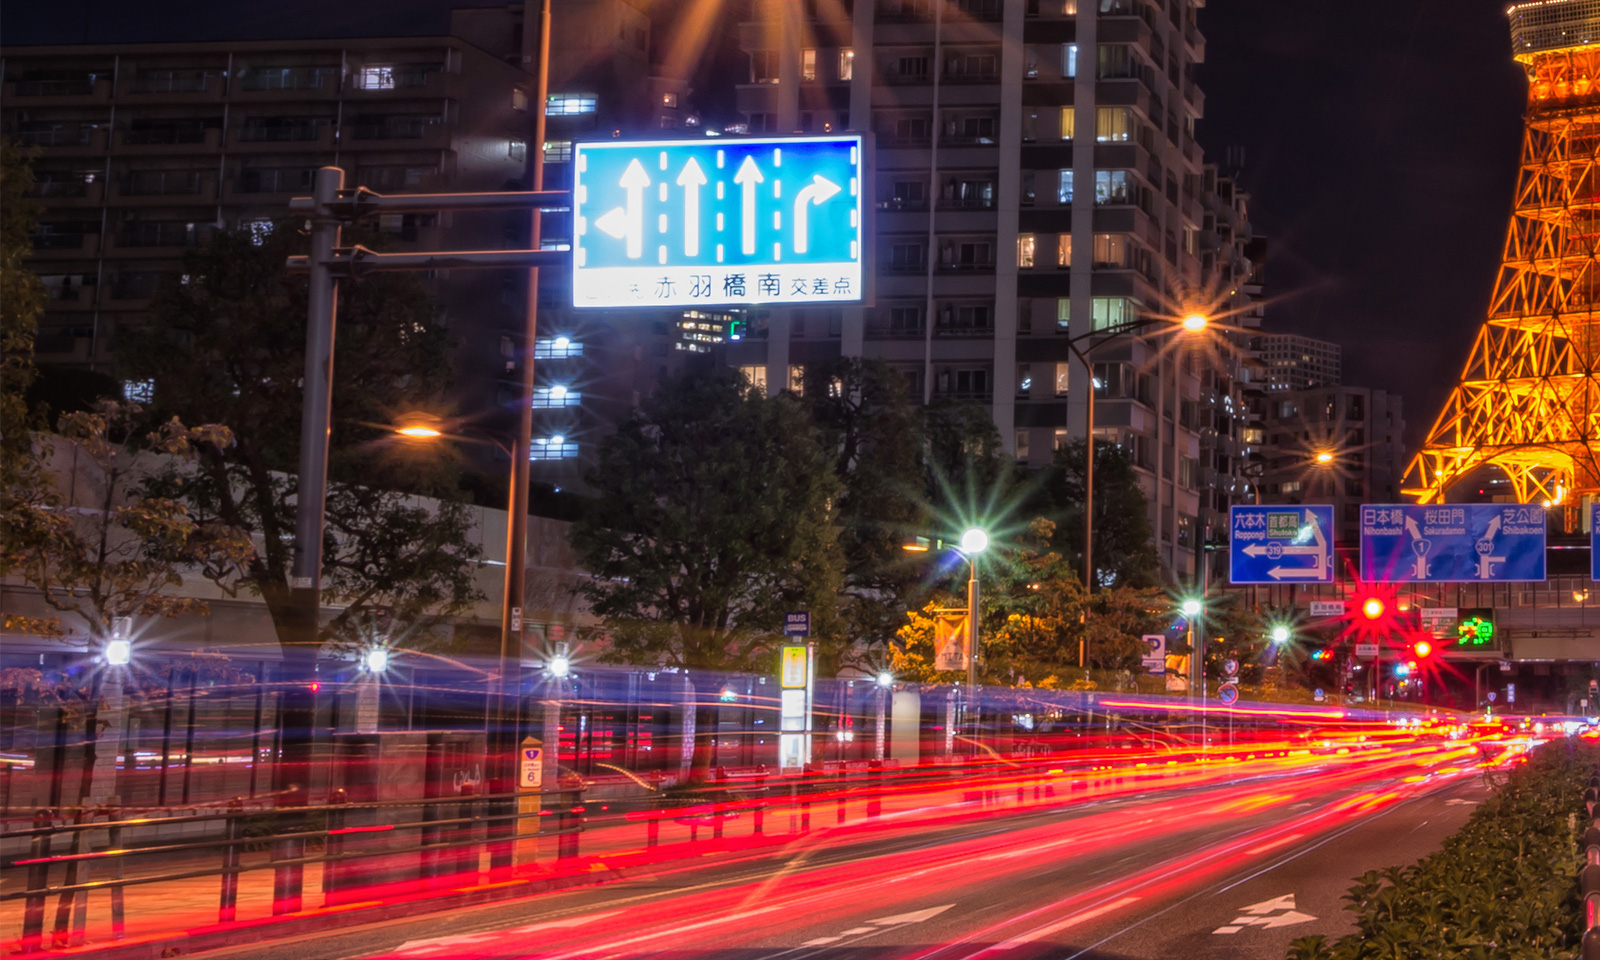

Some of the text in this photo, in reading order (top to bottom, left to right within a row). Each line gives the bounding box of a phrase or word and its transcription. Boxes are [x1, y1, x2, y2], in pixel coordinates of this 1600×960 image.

[1234, 513, 1265, 529] 六本木
[1269, 515, 1297, 528] 首都高
[1363, 509, 1403, 525] 日本橋
[1424, 509, 1464, 525] 桜田門
[1502, 509, 1543, 525] 芝公園
[1234, 530, 1265, 540] Roppongi
[1363, 526, 1402, 536] Nihonbashi
[1423, 526, 1465, 536] Sakuradamon
[1502, 526, 1544, 536] Shibakoen
[1268, 545, 1281, 555] 319
[1418, 542, 1424, 553] 1
[1477, 541, 1491, 552] 301
[788, 614, 806, 622] BUS
[527, 772, 535, 782] 6
